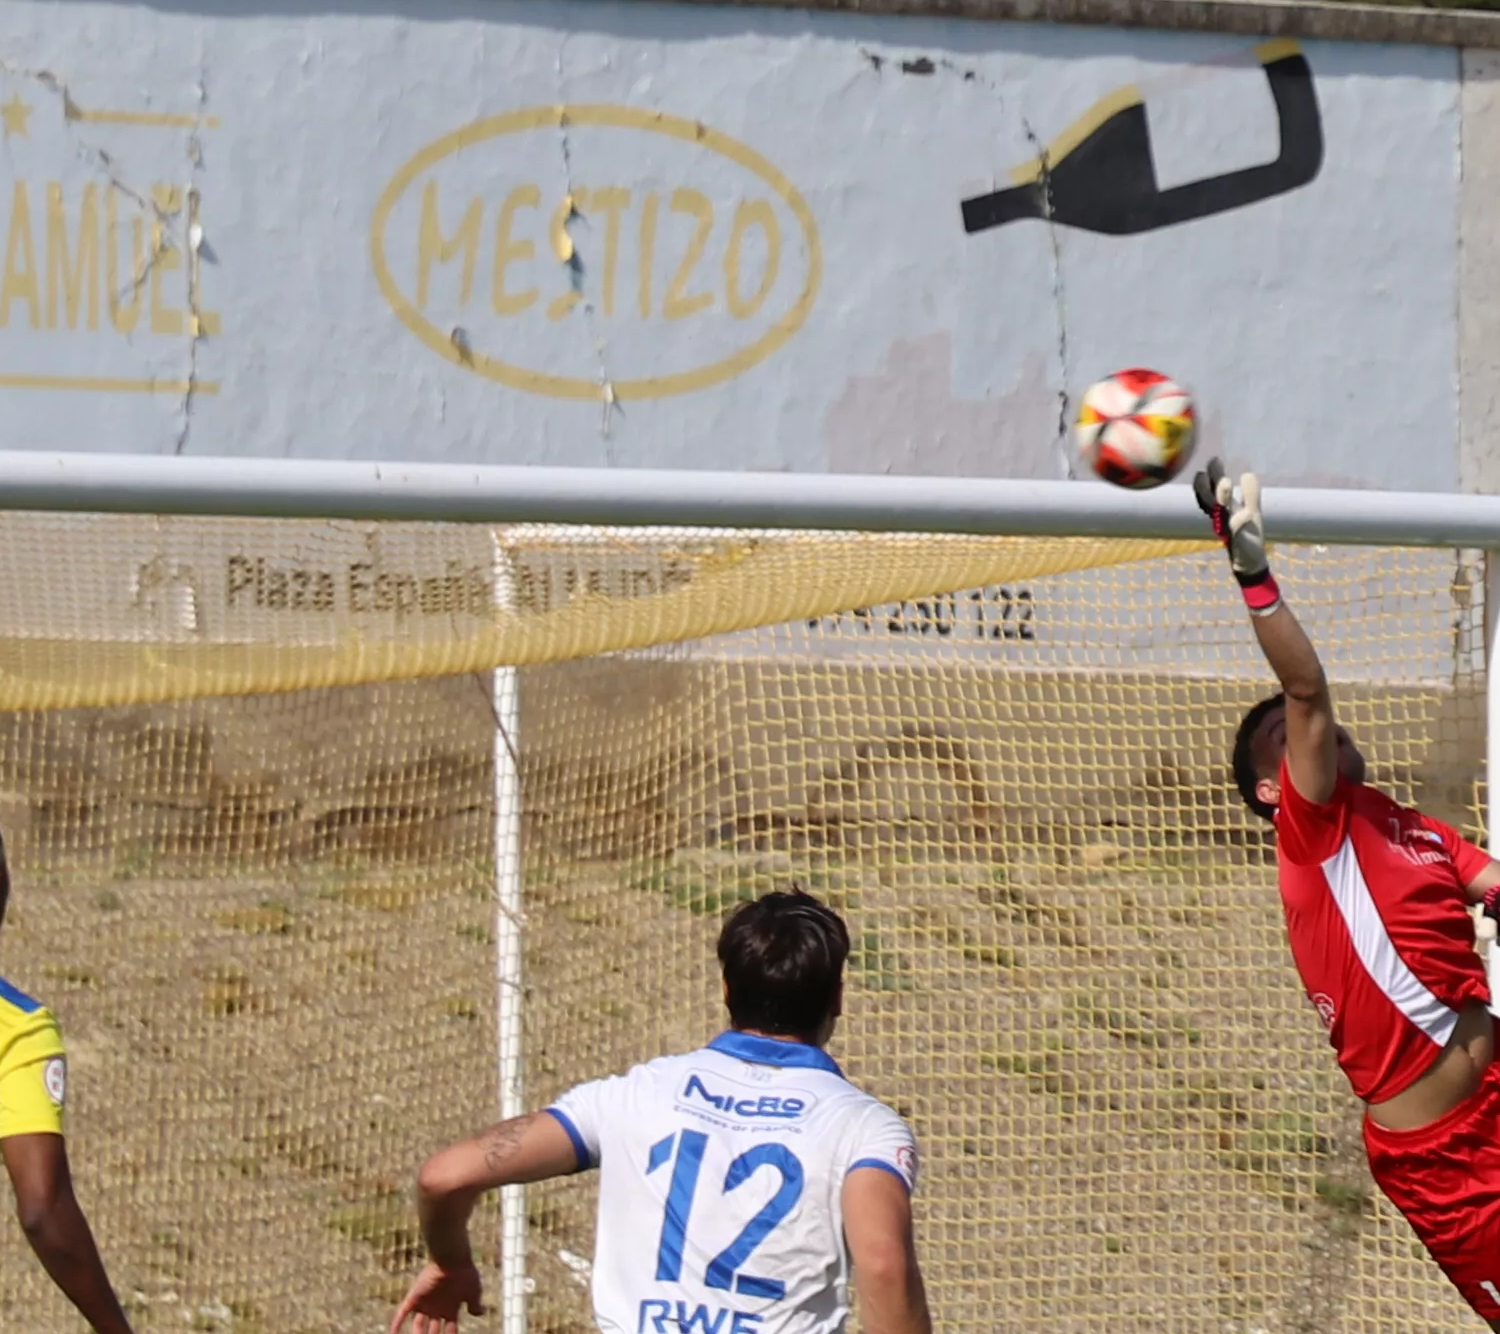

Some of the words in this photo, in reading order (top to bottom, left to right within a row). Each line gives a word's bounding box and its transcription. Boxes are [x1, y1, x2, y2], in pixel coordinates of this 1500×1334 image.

[415, 179, 782, 323] MESTIZO
[227, 553, 336, 612] Plaza
[644, 1128, 806, 1302] 12
